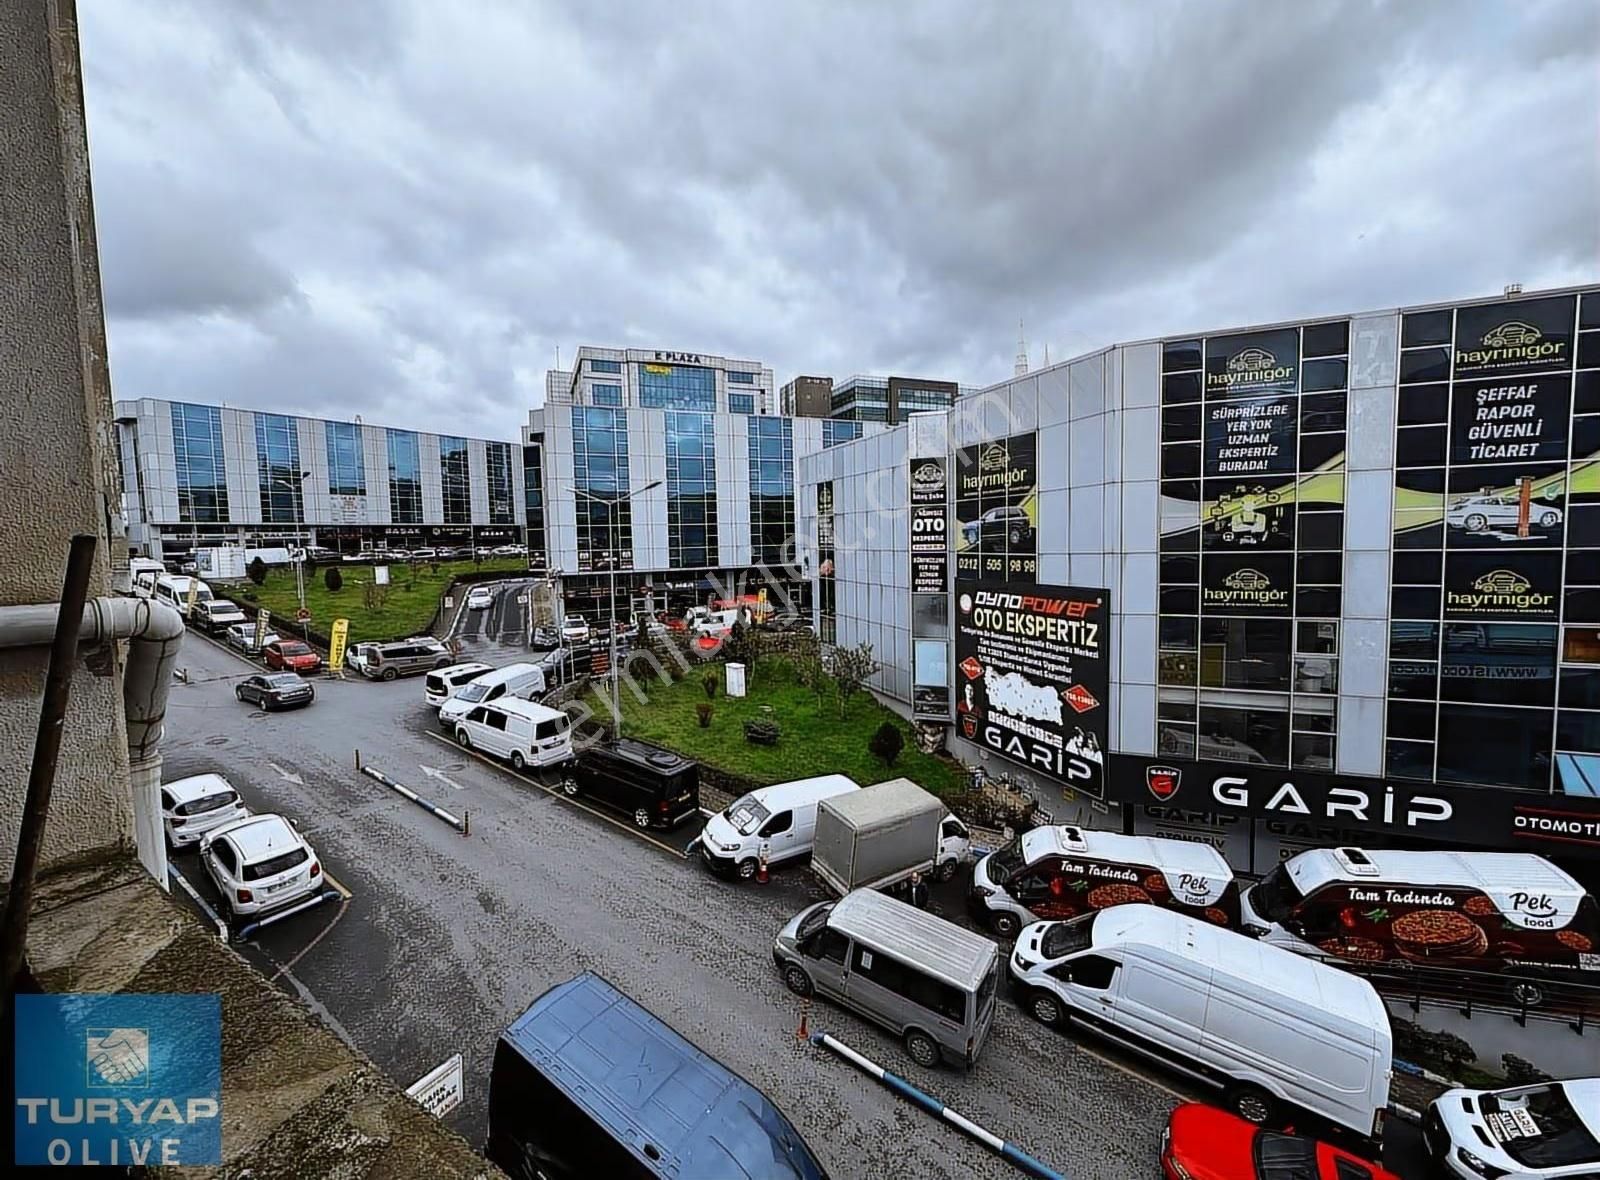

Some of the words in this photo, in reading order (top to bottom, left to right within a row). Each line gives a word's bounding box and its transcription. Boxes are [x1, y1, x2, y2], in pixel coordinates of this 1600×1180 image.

[666, 352, 701, 364] PLAZA
[1476, 384, 1538, 406] ŞEFFAF
[1212, 404, 1289, 420] SÜRPRİZLERE
[1476, 404, 1536, 421] RAPOR
[1226, 421, 1247, 433] YER
[1250, 419, 1273, 431] YOK
[1468, 419, 1543, 440] GÜVENLİ
[1228, 433, 1270, 445] UZMAN
[1218, 444, 1279, 459] EKSPERTİZ
[1470, 442, 1540, 459] TİCARET
[1218, 460, 1268, 472] BURADA!
[912, 518, 945, 532] OTO
[959, 558, 978, 570] 0212
[1010, 559, 1021, 572] 98
[1024, 560, 1035, 573] 98
[974, 608, 1003, 630] OTO
[1006, 611, 1098, 648] EKSPERTİZ
[985, 726, 1092, 780] GARİP
[1212, 776, 1453, 826] GARİP
[1060, 860, 1084, 874] Tam
[1178, 873, 1209, 891] Pek
[1349, 887, 1380, 902] Tam
[1386, 889, 1455, 906] Tadında
[1509, 892, 1553, 911] Pek
[1524, 917, 1554, 928] food
